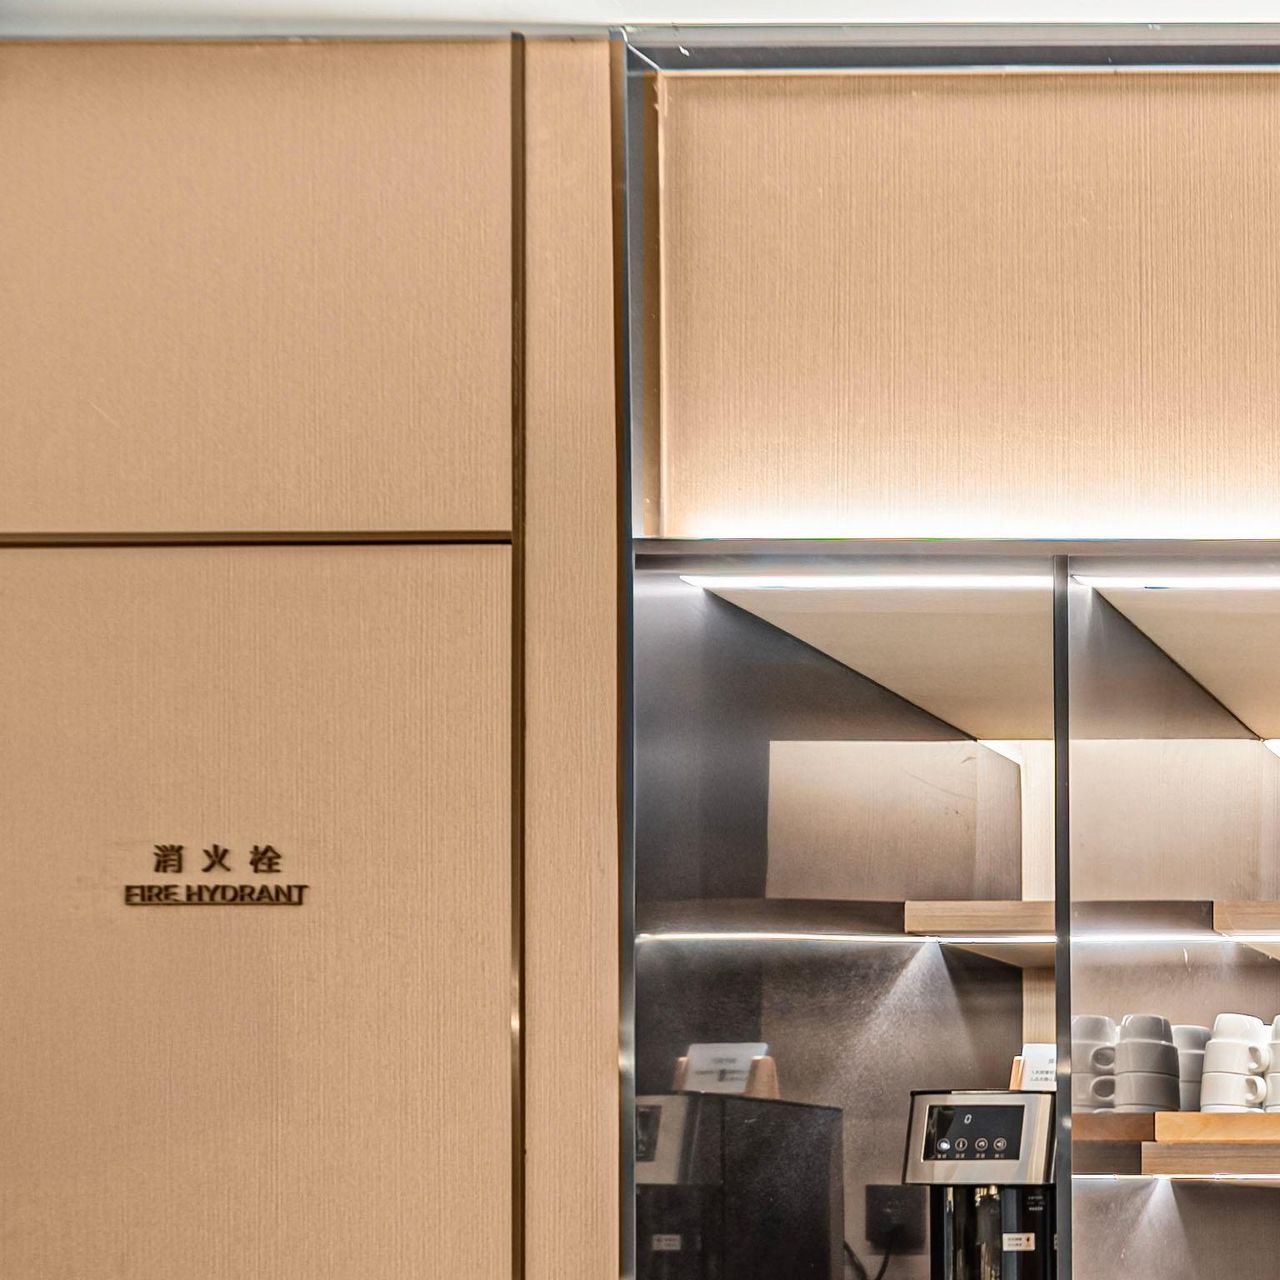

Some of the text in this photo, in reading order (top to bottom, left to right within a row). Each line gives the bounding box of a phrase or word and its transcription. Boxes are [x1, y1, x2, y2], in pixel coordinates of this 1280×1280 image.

[153, 844, 282, 874] 消火栓
[125, 884, 309, 904] FIRE HYDRANT
